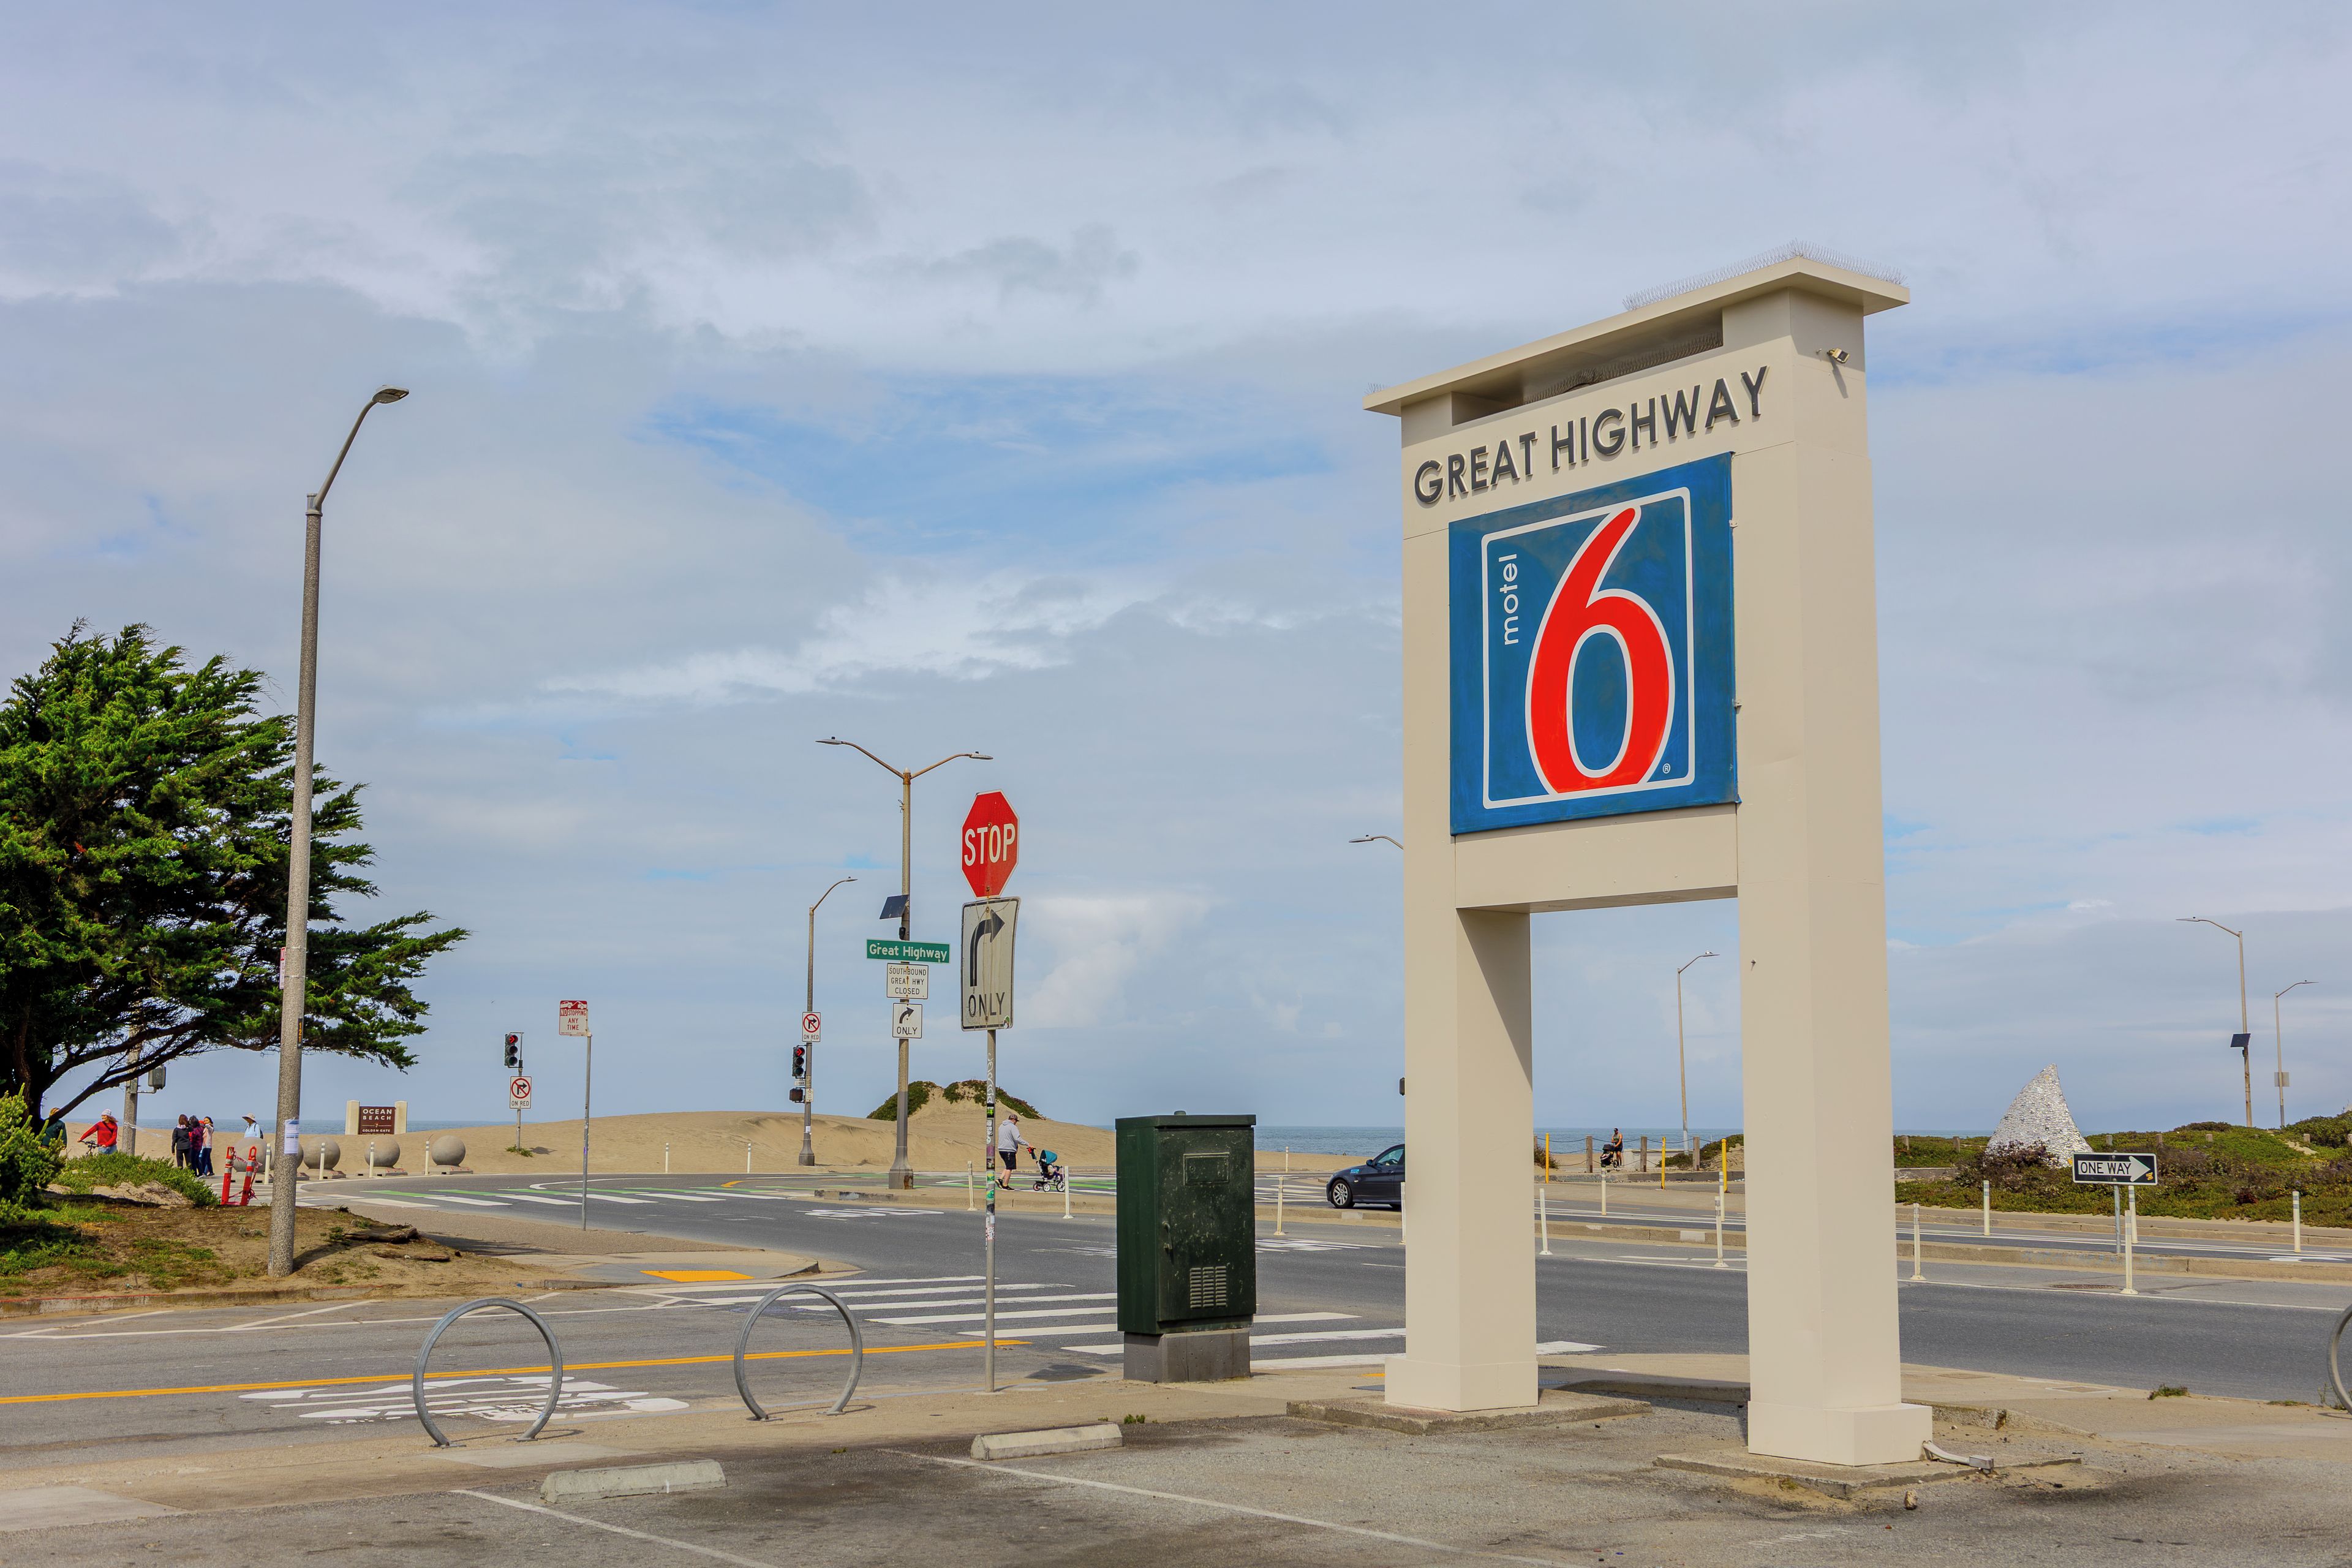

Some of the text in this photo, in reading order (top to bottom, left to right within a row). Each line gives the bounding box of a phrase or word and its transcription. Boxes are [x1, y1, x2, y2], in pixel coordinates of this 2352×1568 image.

[1414, 365, 1769, 504] GREAT HIGHWAY
[1498, 553, 1519, 645] motel
[1527, 506, 1673, 794] 6
[964, 823, 1016, 866] STOP
[869, 943, 948, 961] Great Highway
[889, 967, 927, 976] SOUTHBOUND
[968, 992, 1005, 1017] ONLY
[896, 1026, 918, 1035] ONLY
[2080, 1161, 2132, 1175] ONE WAY
